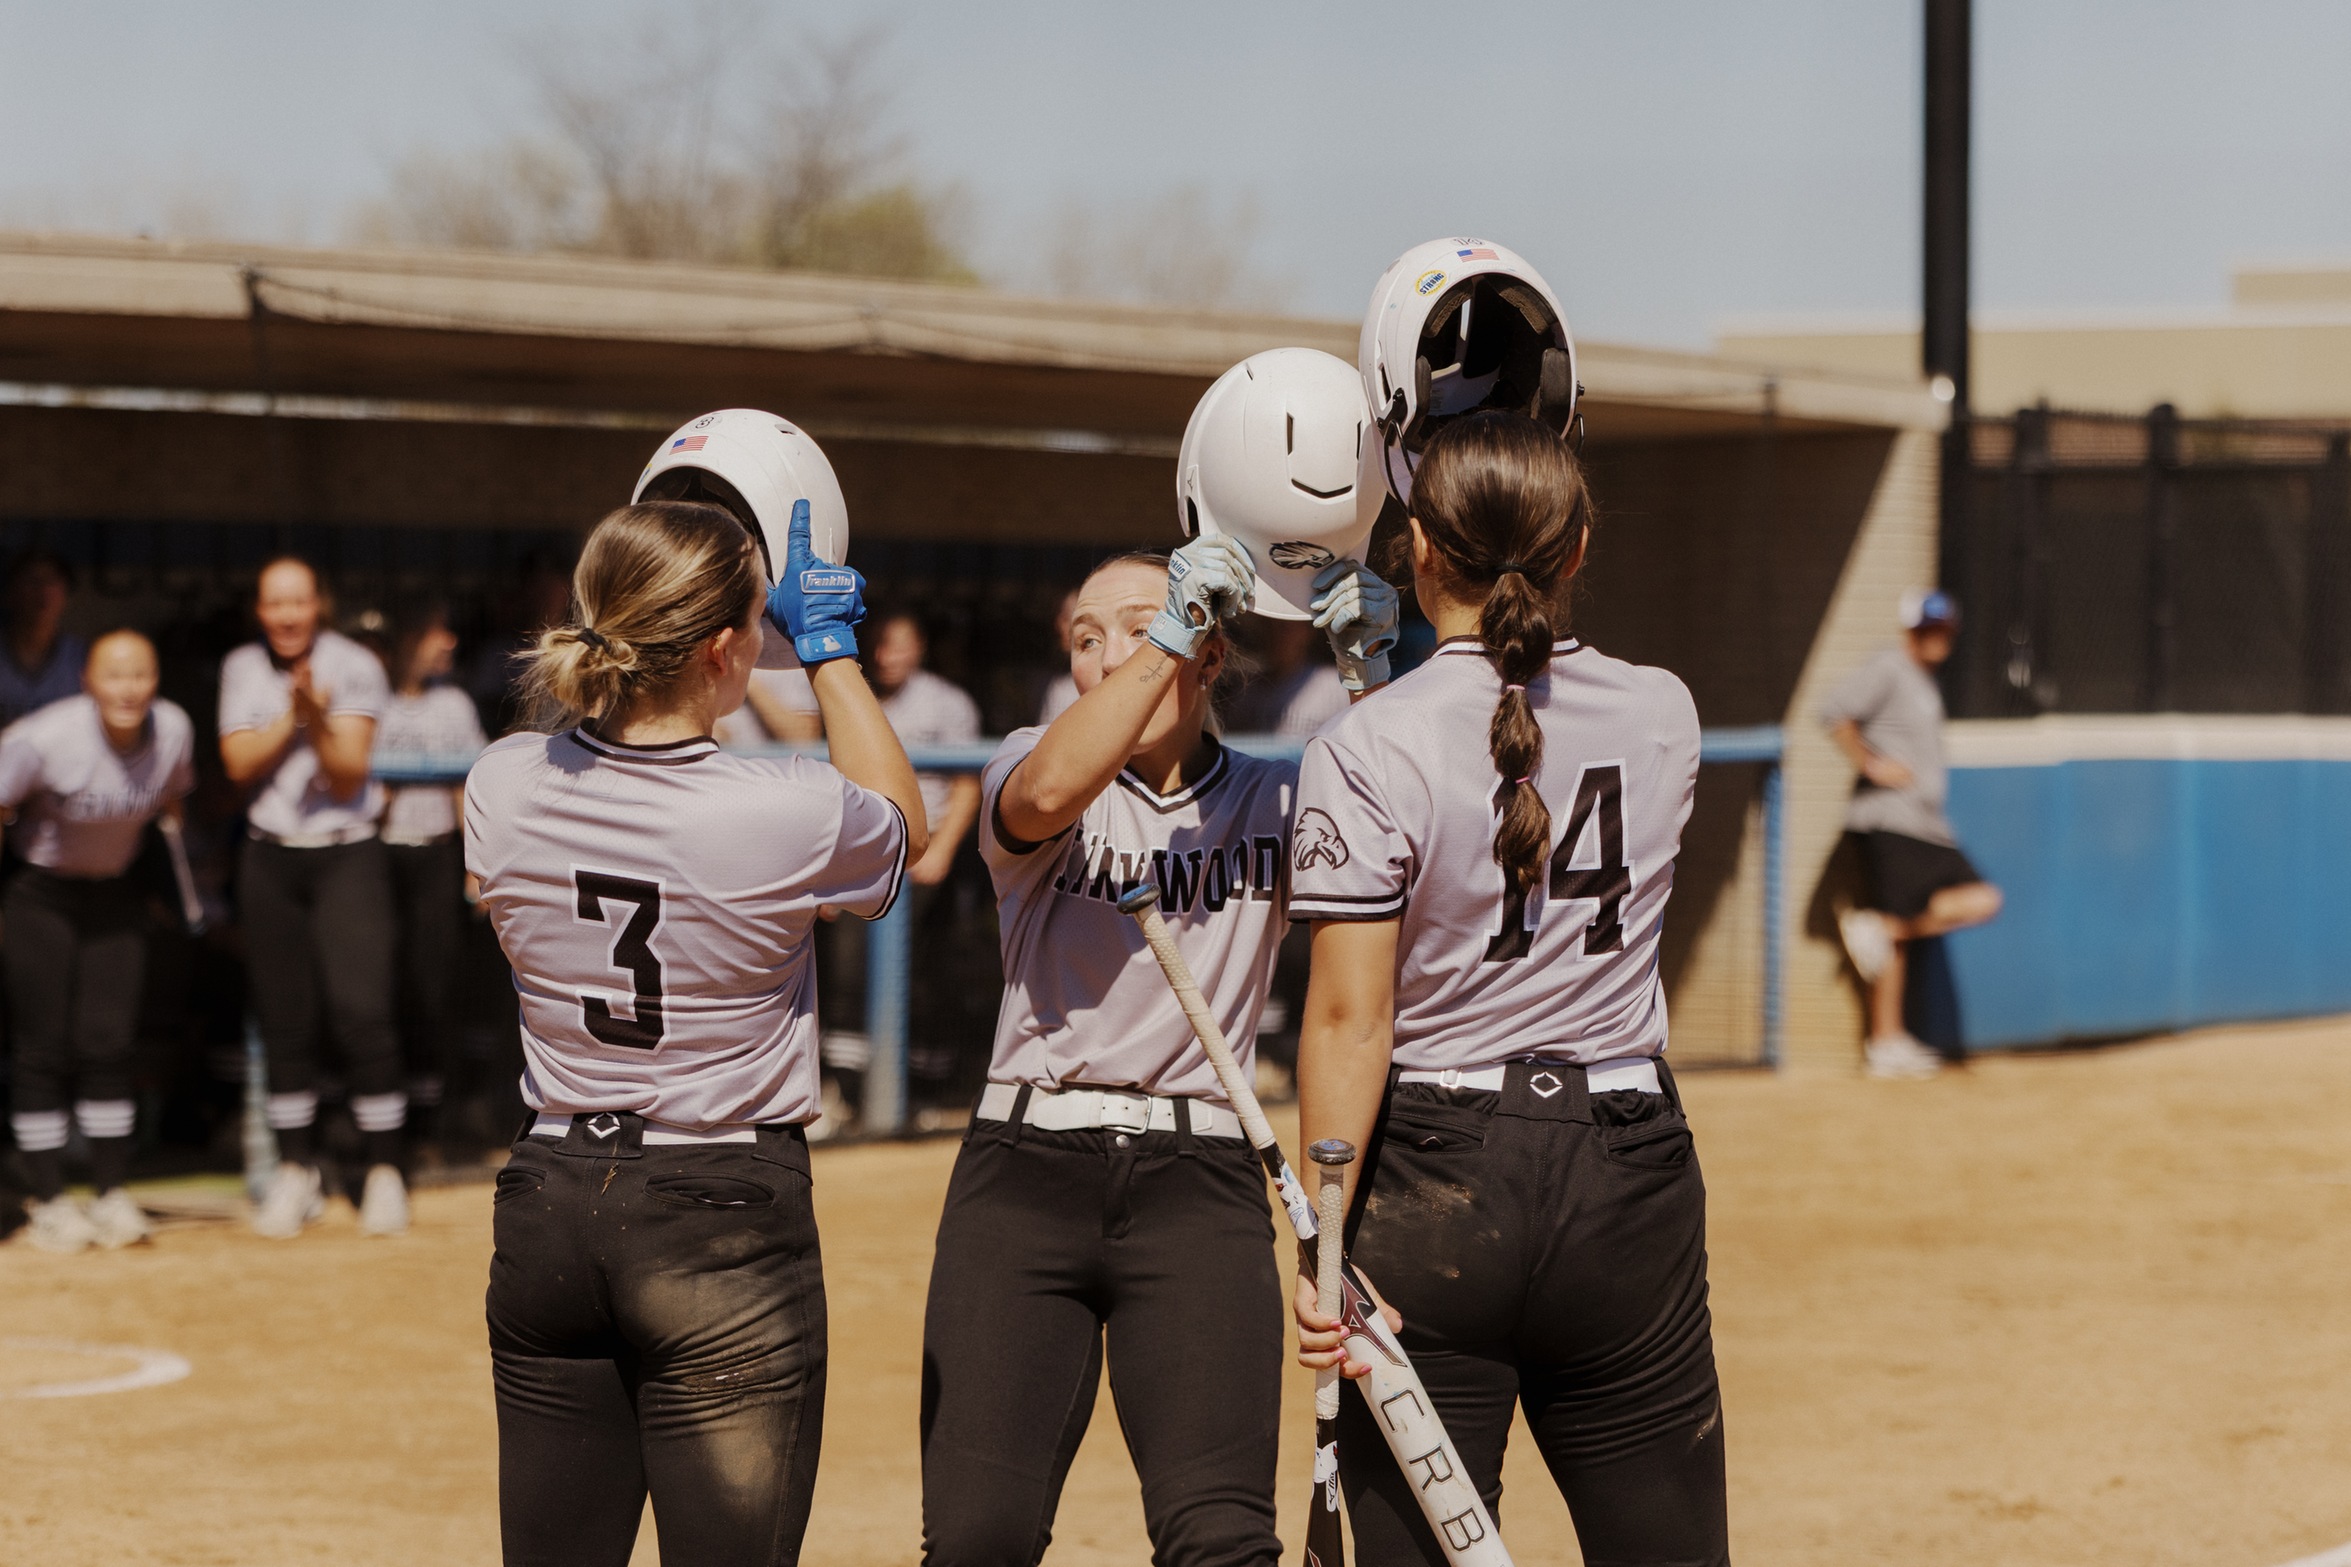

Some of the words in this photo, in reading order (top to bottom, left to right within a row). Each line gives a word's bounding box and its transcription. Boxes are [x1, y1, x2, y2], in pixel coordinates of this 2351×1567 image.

[804, 574, 852, 590] Franklin
[1479, 759, 1634, 966] 14
[570, 864, 670, 1054] 3
